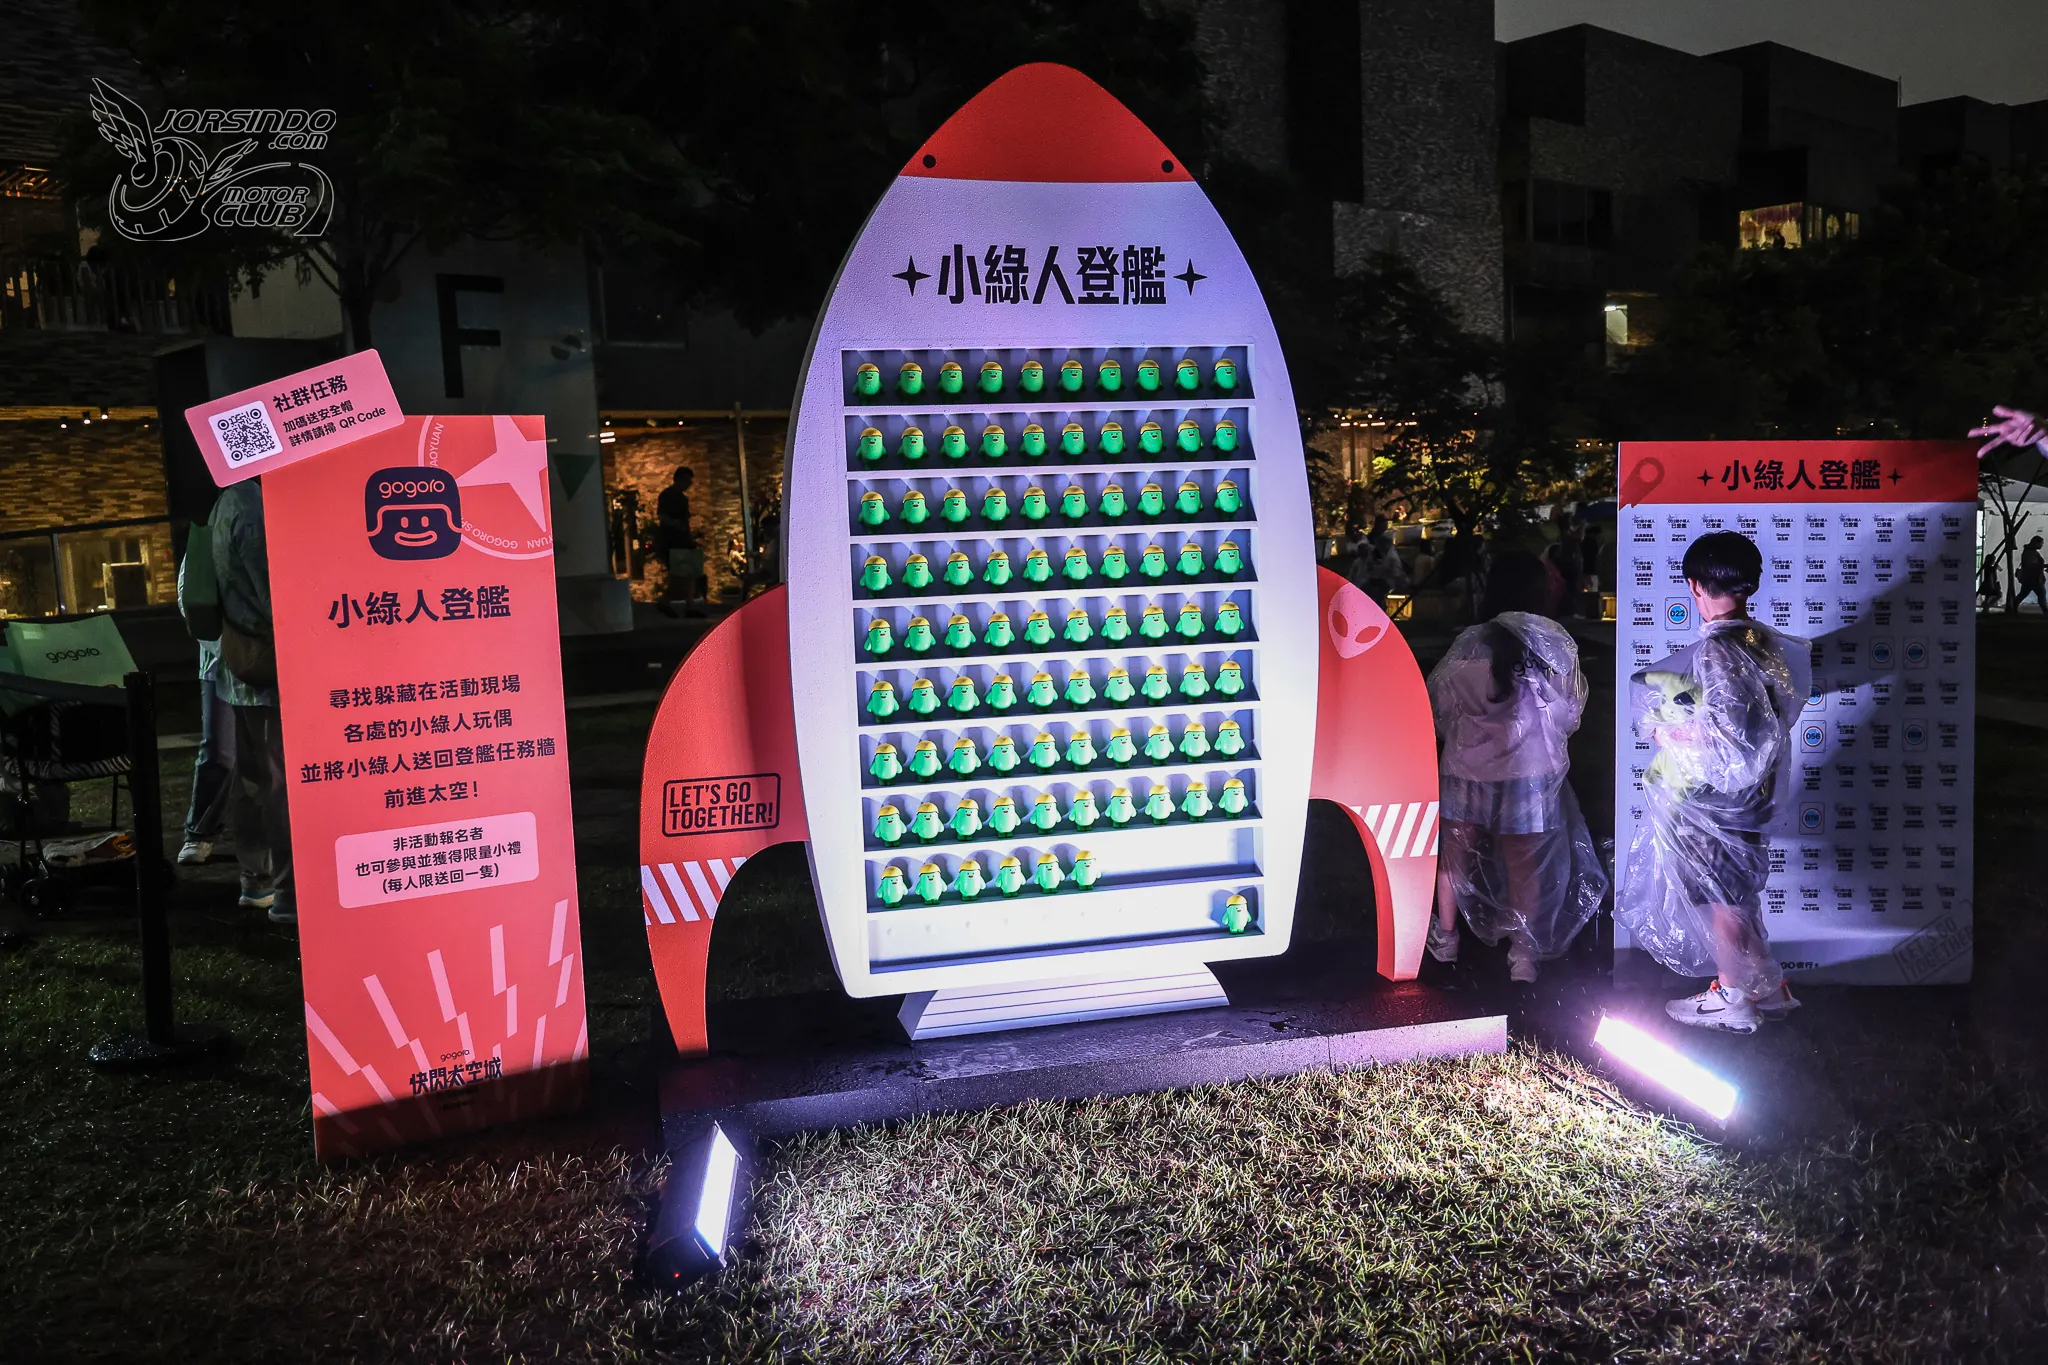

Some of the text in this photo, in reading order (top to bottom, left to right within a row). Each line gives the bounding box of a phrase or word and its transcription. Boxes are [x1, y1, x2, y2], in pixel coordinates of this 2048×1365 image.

[937, 244, 1166, 306] 小綠人登艦
[435, 273, 504, 398] F
[273, 374, 348, 412] 社群任務
[282, 400, 354, 432] 加碼送安全帽
[288, 407, 386, 448] 詳情請掃 QR Code
[430, 422, 444, 468] AOYUAN
[379, 478, 446, 498] gogoro
[1720, 458, 1881, 490] 小綠人登艦
[472, 528, 518, 548] GOGORO
[328, 585, 511, 629] 小綠人登艦
[46, 648, 100, 663] gogoro
[330, 674, 521, 708] 尋找躲藏在活動現場
[344, 709, 512, 743] 各處的小綠人玩偶
[300, 738, 556, 784] 並將小綠人送回登艦任務牆
[670, 782, 751, 808] LET'S GO
[669, 802, 773, 830] TOGETHER!
[393, 826, 484, 851] 非活動報名者
[355, 840, 522, 876] 也可參與並獲得限量小禮
[382, 862, 500, 894] (每人限送回一隻)
[440, 1050, 470, 1062] gogoro
[410, 1056, 502, 1095] 快閃太空城
